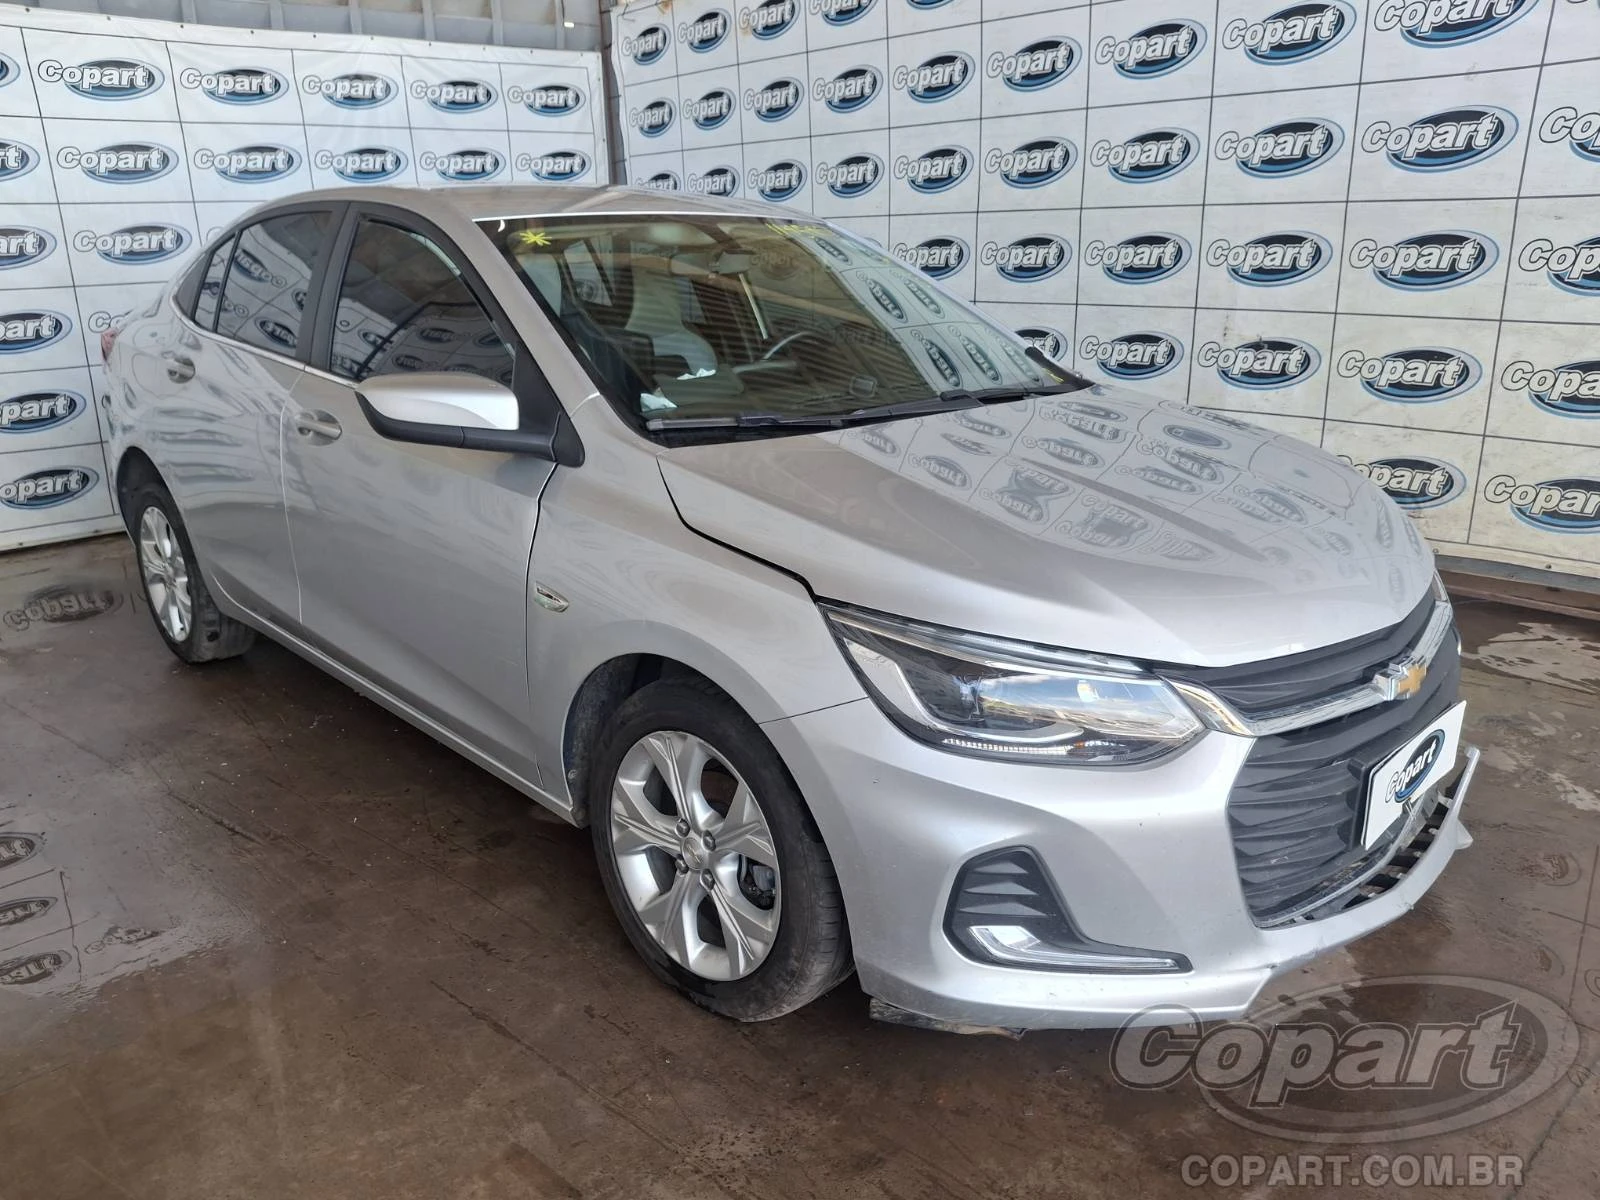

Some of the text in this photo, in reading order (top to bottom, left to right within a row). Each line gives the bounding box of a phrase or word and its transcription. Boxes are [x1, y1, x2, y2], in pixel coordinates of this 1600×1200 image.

[677, 16, 726, 46] Copart
[738, 1, 793, 32] Copart
[1222, 7, 1341, 54] Copart
[622, 30, 665, 57] Copart
[1095, 25, 1193, 70] Copart
[38, 59, 150, 90] Copart
[893, 56, 964, 94] Copart
[986, 42, 1070, 82] Copart
[180, 68, 275, 96] Copart
[302, 75, 387, 98] Copart
[410, 79, 488, 103] Copart
[508, 86, 577, 105] Copart
[812, 72, 875, 103] Copart
[682, 96, 731, 124] Copart
[744, 83, 797, 114] Copart
[629, 105, 672, 128] Copart
[1215, 125, 1331, 165] Copart
[1361, 112, 1499, 159] Copart
[57, 146, 163, 175] Copart
[194, 148, 289, 176] Copart
[314, 150, 396, 174] Copart
[419, 151, 498, 174] Copart
[515, 152, 586, 173] Copart
[893, 151, 964, 184] Copart
[985, 143, 1068, 175] Copart
[1091, 134, 1188, 173] Copart
[749, 165, 802, 195] Copart
[815, 158, 876, 188] Copart
[73, 228, 177, 256] Copart
[981, 241, 1061, 272] Copart
[1085, 239, 1180, 272] Copart
[1206, 238, 1319, 274] Copart
[1349, 238, 1480, 277] Copart
[1518, 238, 1600, 281] Cop
[0, 314, 56, 341] art
[1079, 333, 1171, 368] Copart
[1198, 342, 1308, 376] Copart
[1337, 350, 1465, 389] Copart
[1501, 360, 1600, 402] Copa
[0, 394, 71, 426] part
[0, 470, 83, 504] opart
[1336, 455, 1449, 497] part
[1484, 474, 1600, 517] Copar
[1385, 738, 1438, 803] Copart
